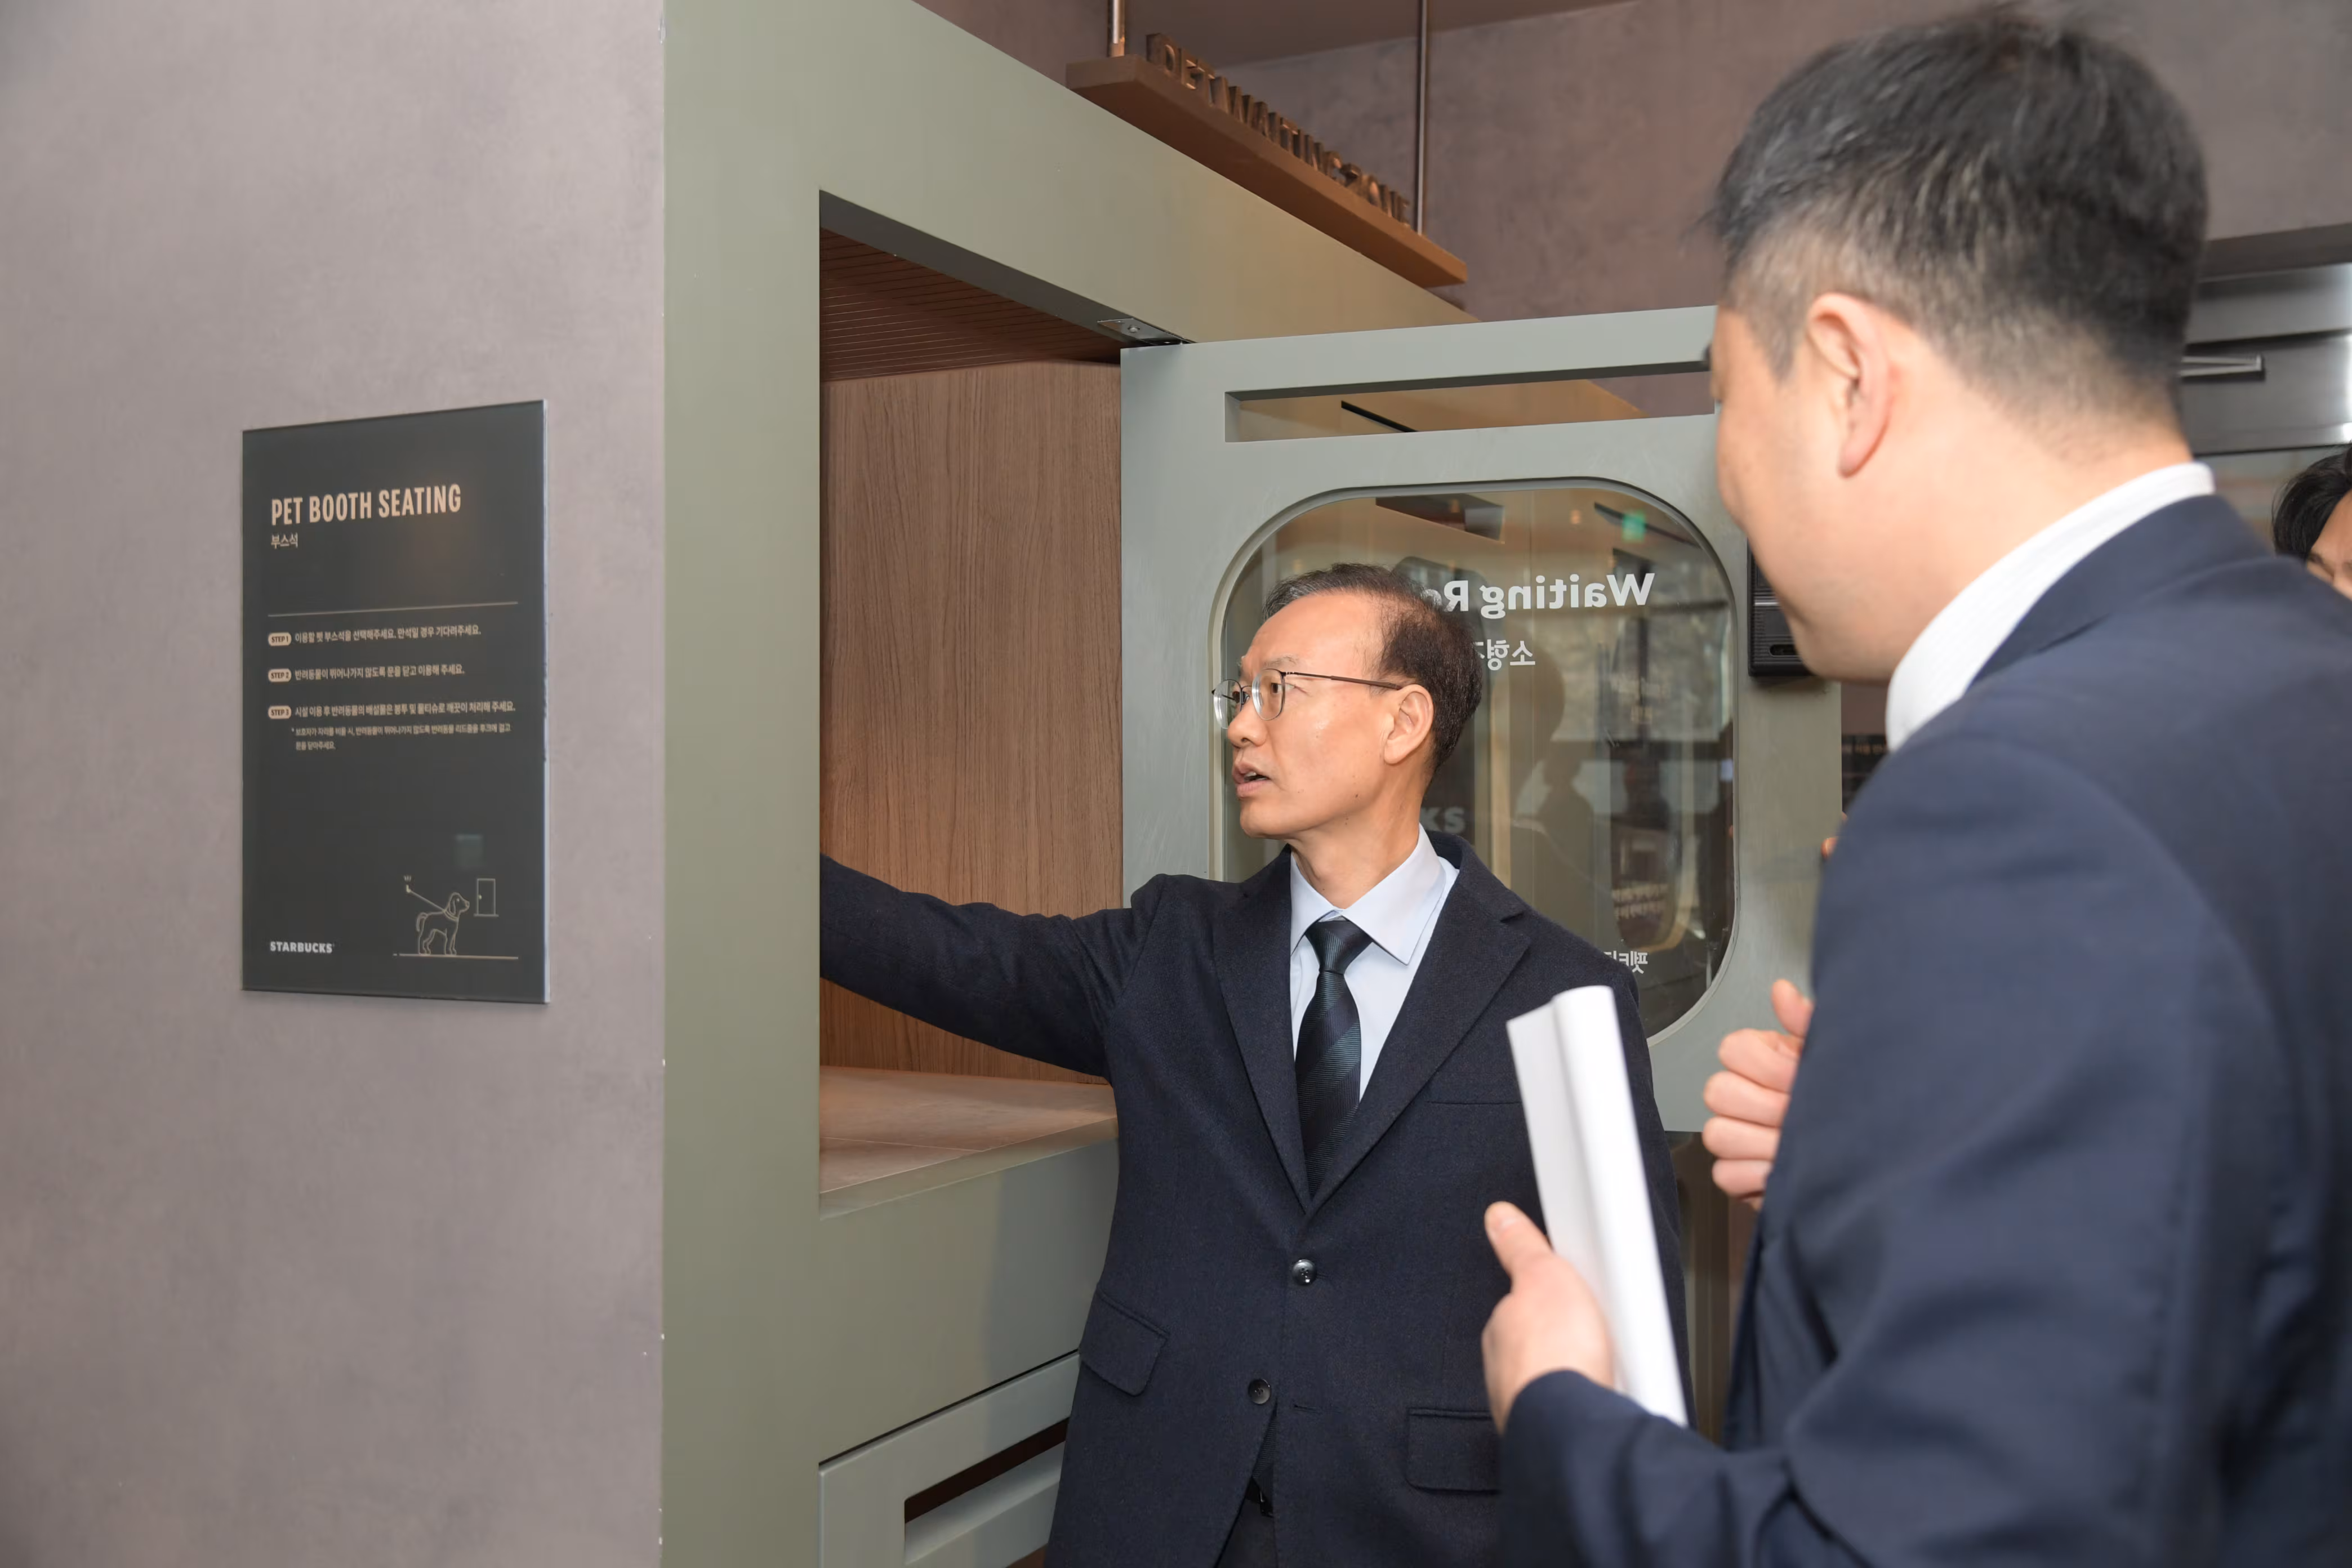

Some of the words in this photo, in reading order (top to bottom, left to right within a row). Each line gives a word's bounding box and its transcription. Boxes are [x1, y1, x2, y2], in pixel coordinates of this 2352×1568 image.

[271, 496, 303, 525] PET
[309, 492, 372, 523] BOOTH
[378, 483, 461, 519] SEATING
[270, 532, 299, 549] 부스석
[295, 631, 315, 643] 이용할
[324, 630, 351, 643] 부스석을
[353, 628, 397, 641] 선택해주세요.
[398, 626, 419, 639] 만석일
[420, 626, 434, 638] 경우
[436, 624, 482, 637] 기다려주세요.
[295, 668, 328, 680] 반려동물이
[330, 667, 364, 679] 뛰어나가지
[365, 666, 386, 678] 않도록
[387, 666, 401, 678] 문을
[402, 665, 417, 676] 닫고
[418, 664, 439, 676] 이용해
[441, 663, 465, 675] 주세요.
[295, 706, 308, 717] 시설
[309, 705, 322, 717] 이용
[332, 704, 365, 716] 반려동물의
[469, 701, 490, 712] 처리해
[492, 700, 515, 712] 주세요.
[270, 941, 333, 954] STARBUCKS
